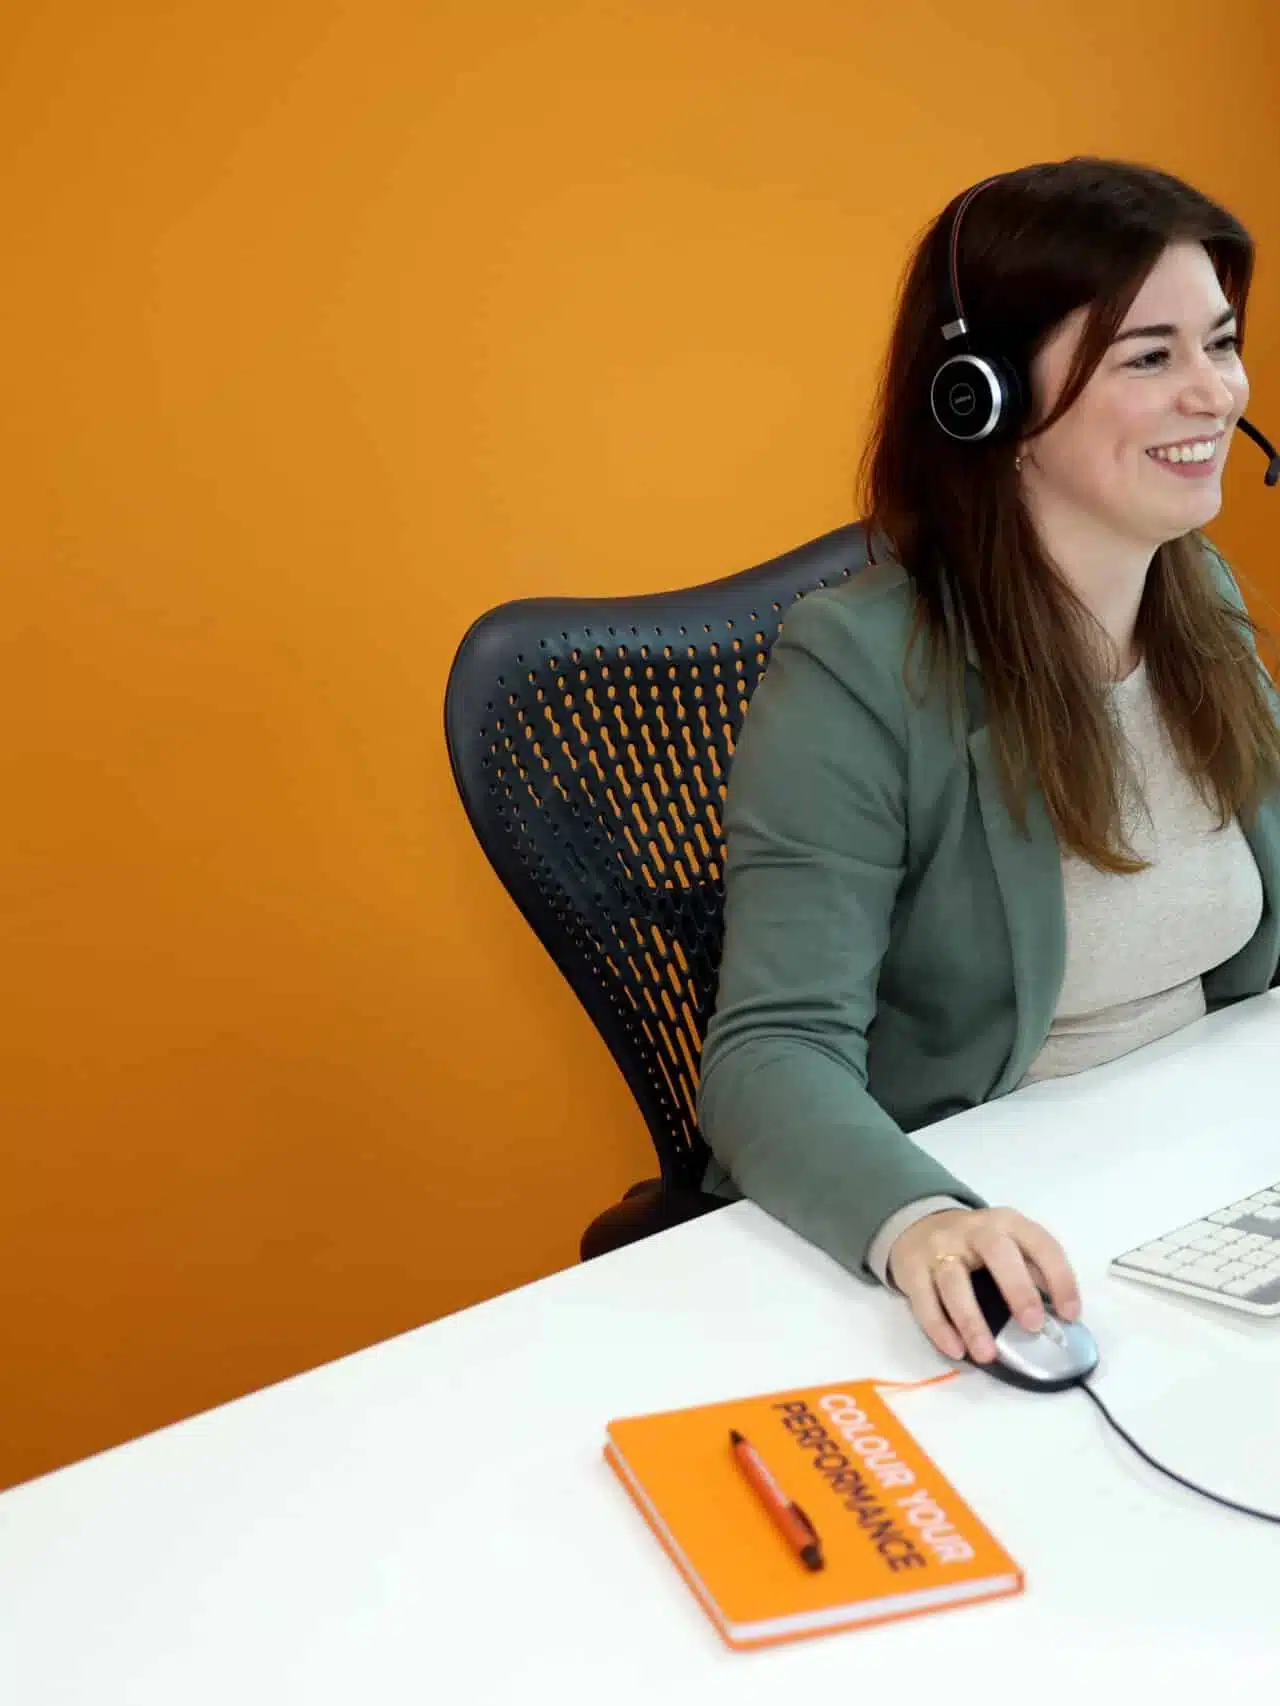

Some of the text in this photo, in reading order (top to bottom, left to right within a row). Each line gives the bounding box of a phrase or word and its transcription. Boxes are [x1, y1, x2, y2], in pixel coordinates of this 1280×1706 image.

[773, 1400, 927, 1573] PERFORMANCE
[819, 1393, 975, 1563] COLOUR YOUR
